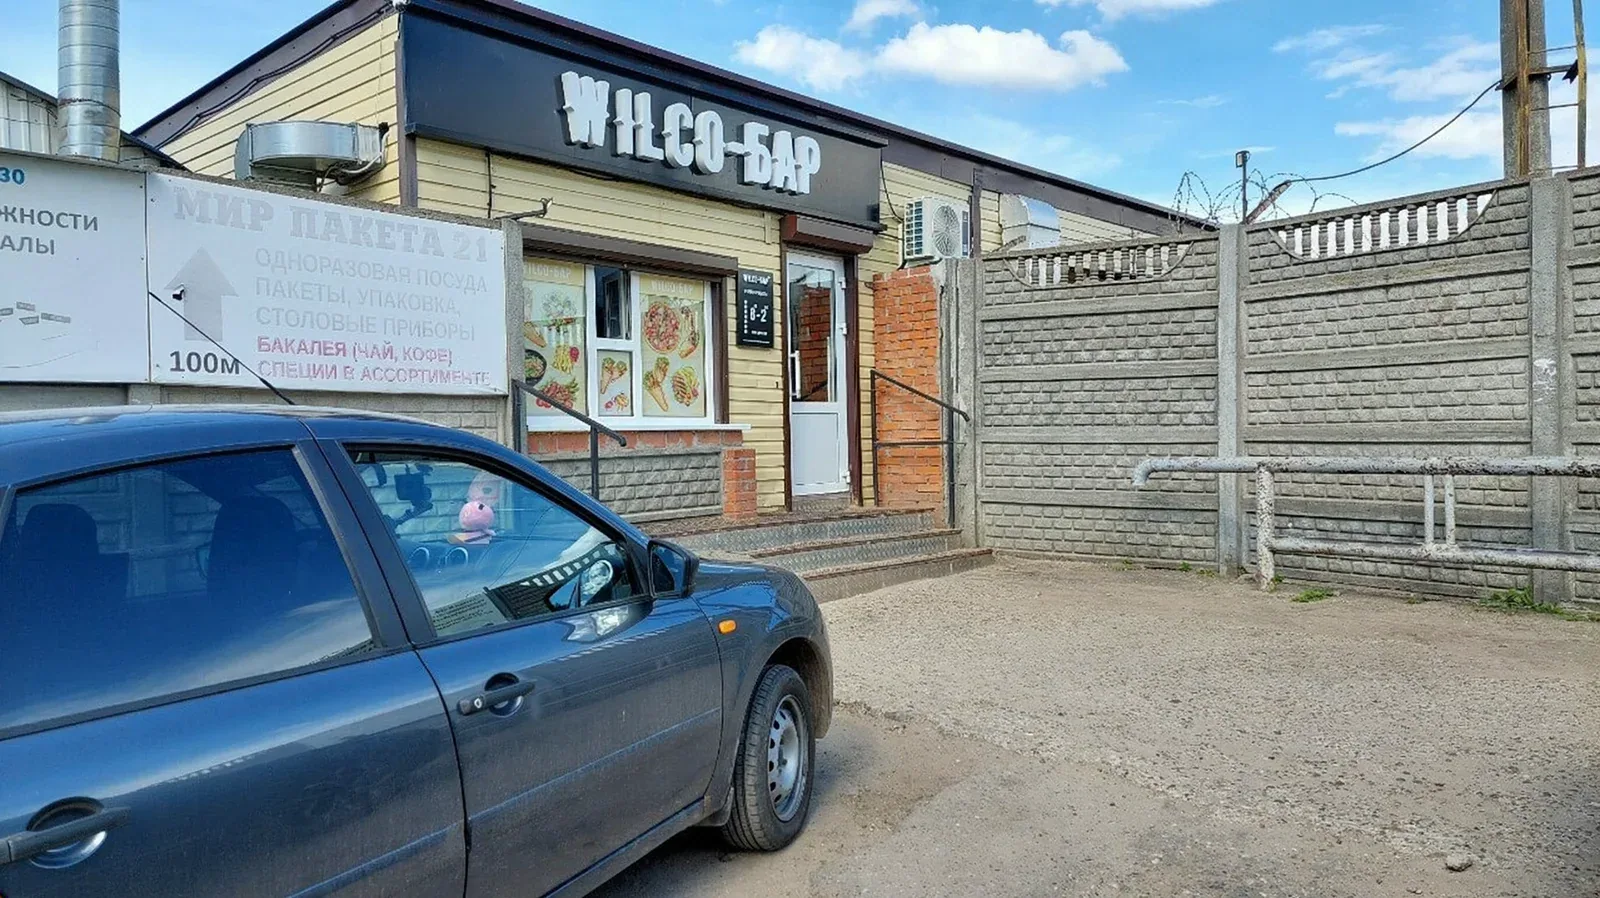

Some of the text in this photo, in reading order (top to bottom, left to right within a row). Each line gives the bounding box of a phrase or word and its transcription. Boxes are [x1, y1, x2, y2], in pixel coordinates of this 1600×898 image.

[561, 70, 821, 194] WILCO-БАР
[0, 167, 25, 186] 30
[173, 186, 488, 262] МИР ПАКЕТА 21
[0, 234, 55, 255] АЛЫ
[255, 247, 488, 295] ОДНОРАЗОВАЯ ПОСУДА
[256, 276, 461, 317] ПАКЕТЫ, УПАКОВКА,
[256, 306, 475, 342] СТОЛОВЫЕ ПРИБОРЫ
[257, 335, 453, 367] БАКАЛЕЯ (ЧАЙ, КОФЕ)
[258, 360, 337, 382] СПЕЦИИ
[360, 366, 491, 387] АССОРТИМЕНТЕ
